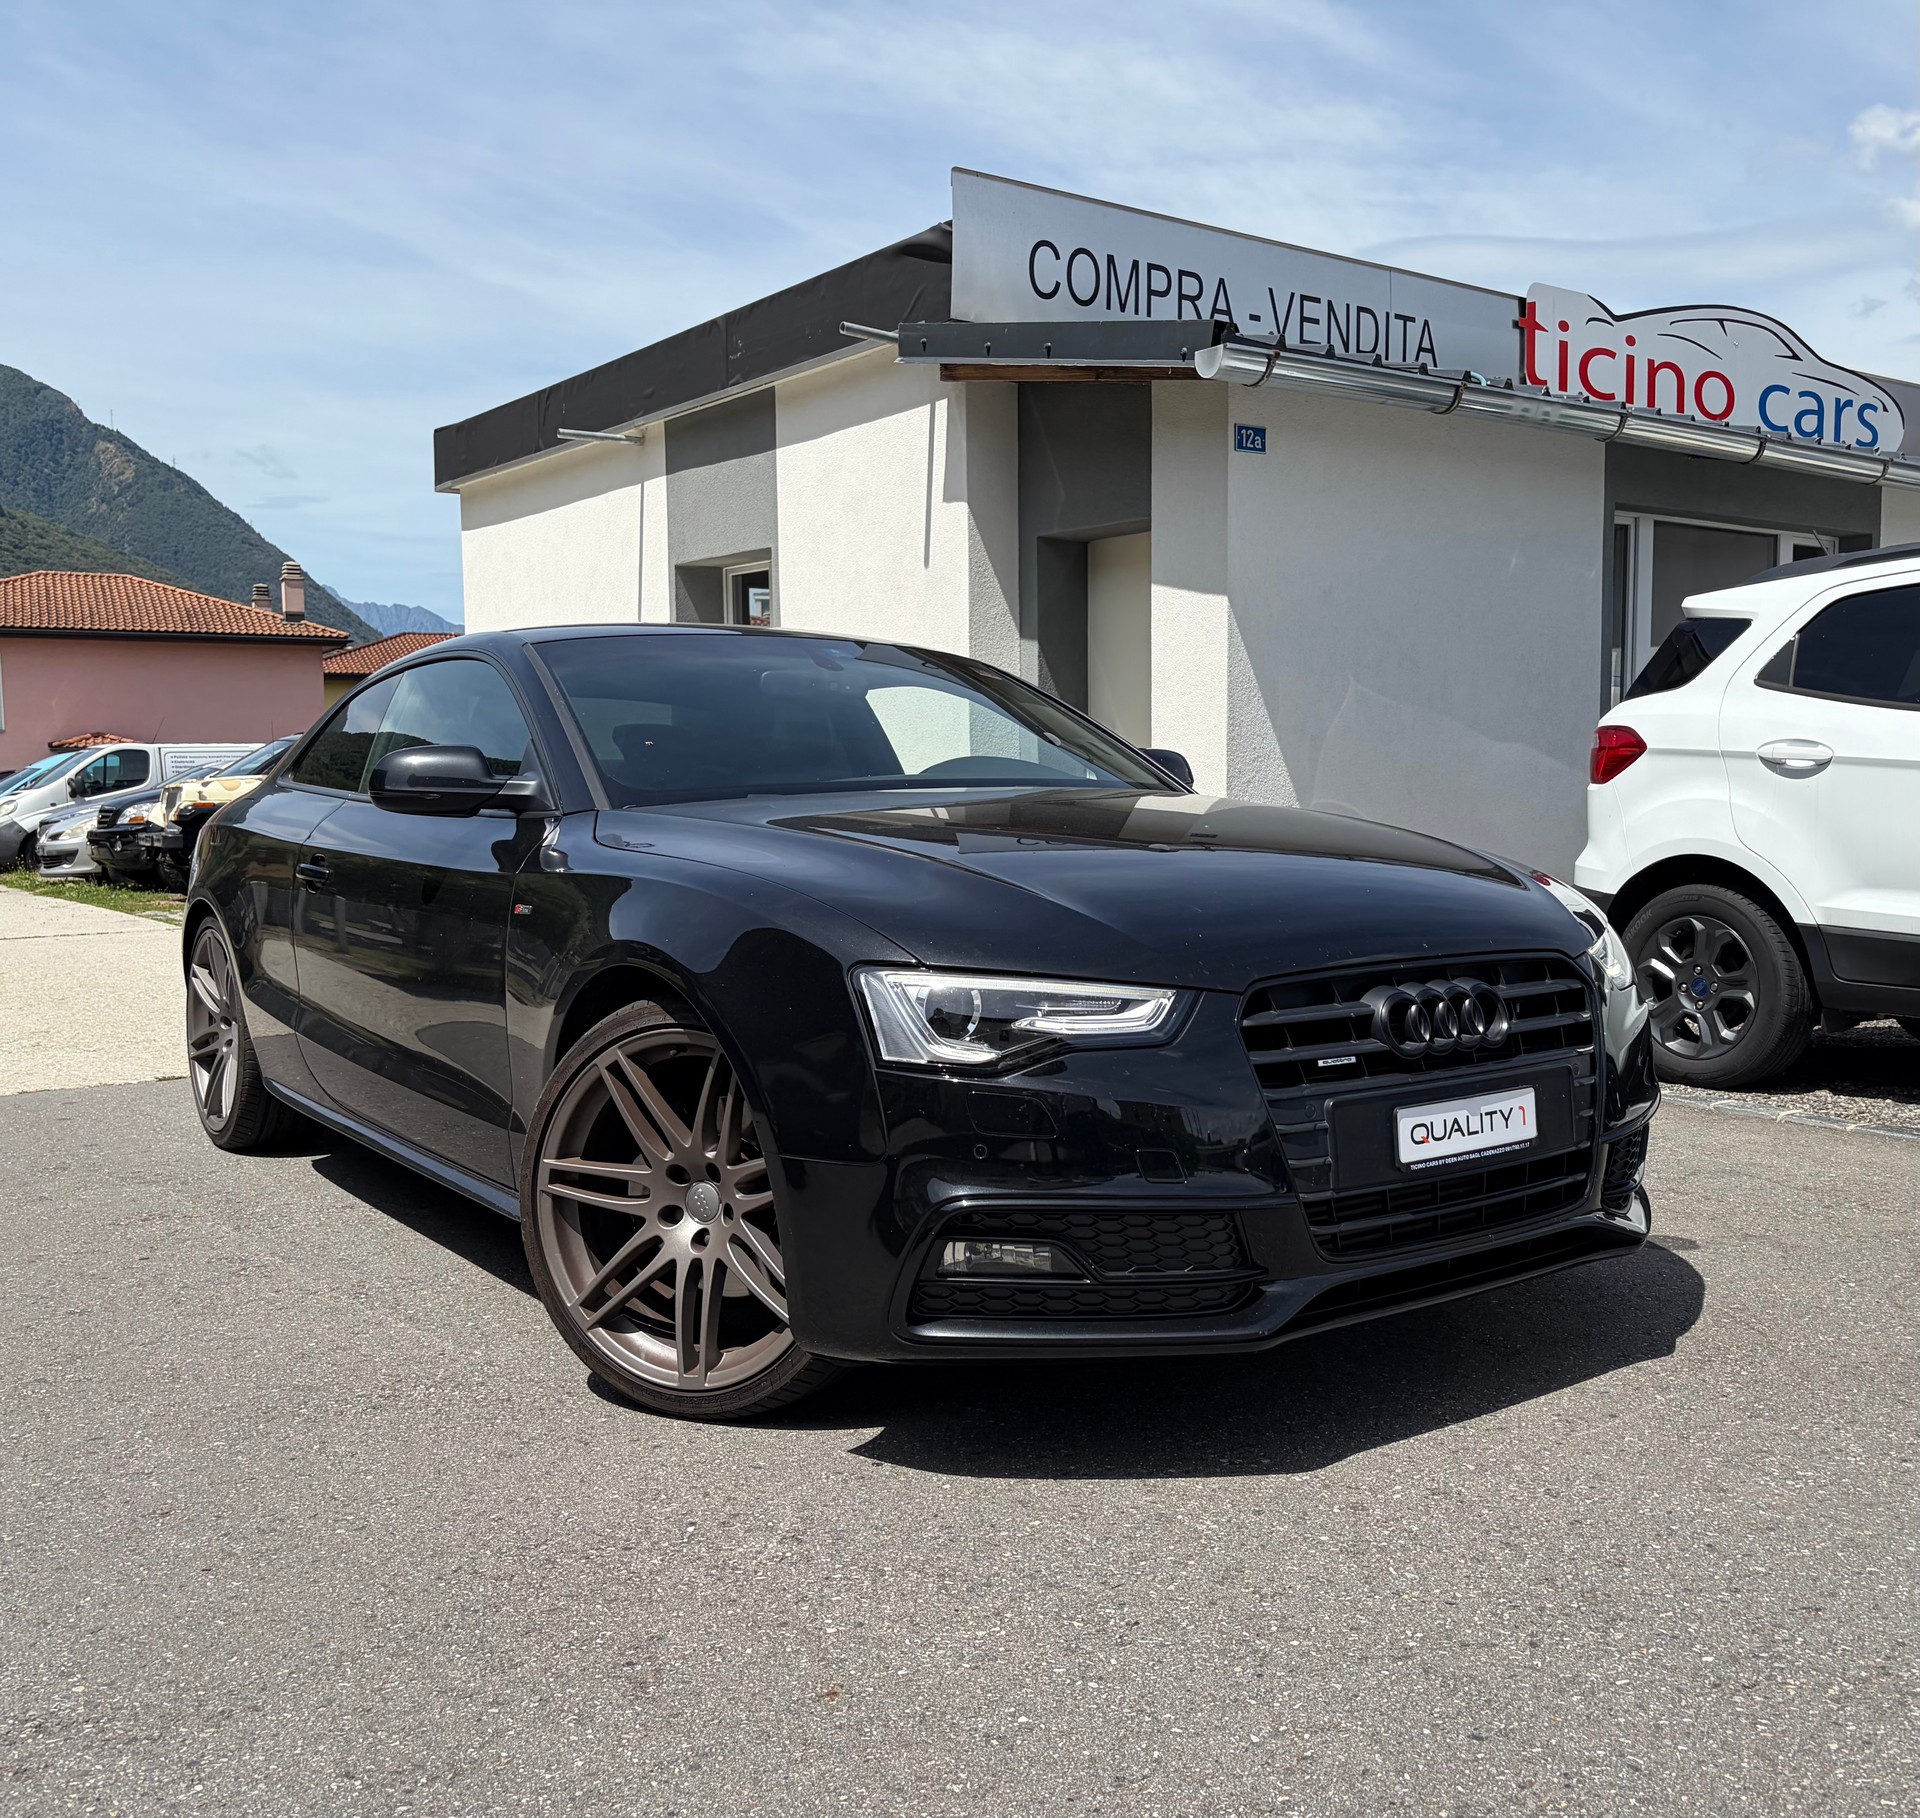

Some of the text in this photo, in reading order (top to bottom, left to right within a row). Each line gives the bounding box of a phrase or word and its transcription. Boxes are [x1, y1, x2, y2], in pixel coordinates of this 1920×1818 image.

[1028, 239, 1234, 322] COMPRA
[1268, 287, 1438, 367] VENDITA
[1517, 301, 1879, 448] ticino cars
[1240, 429, 1262, 449] 12a
